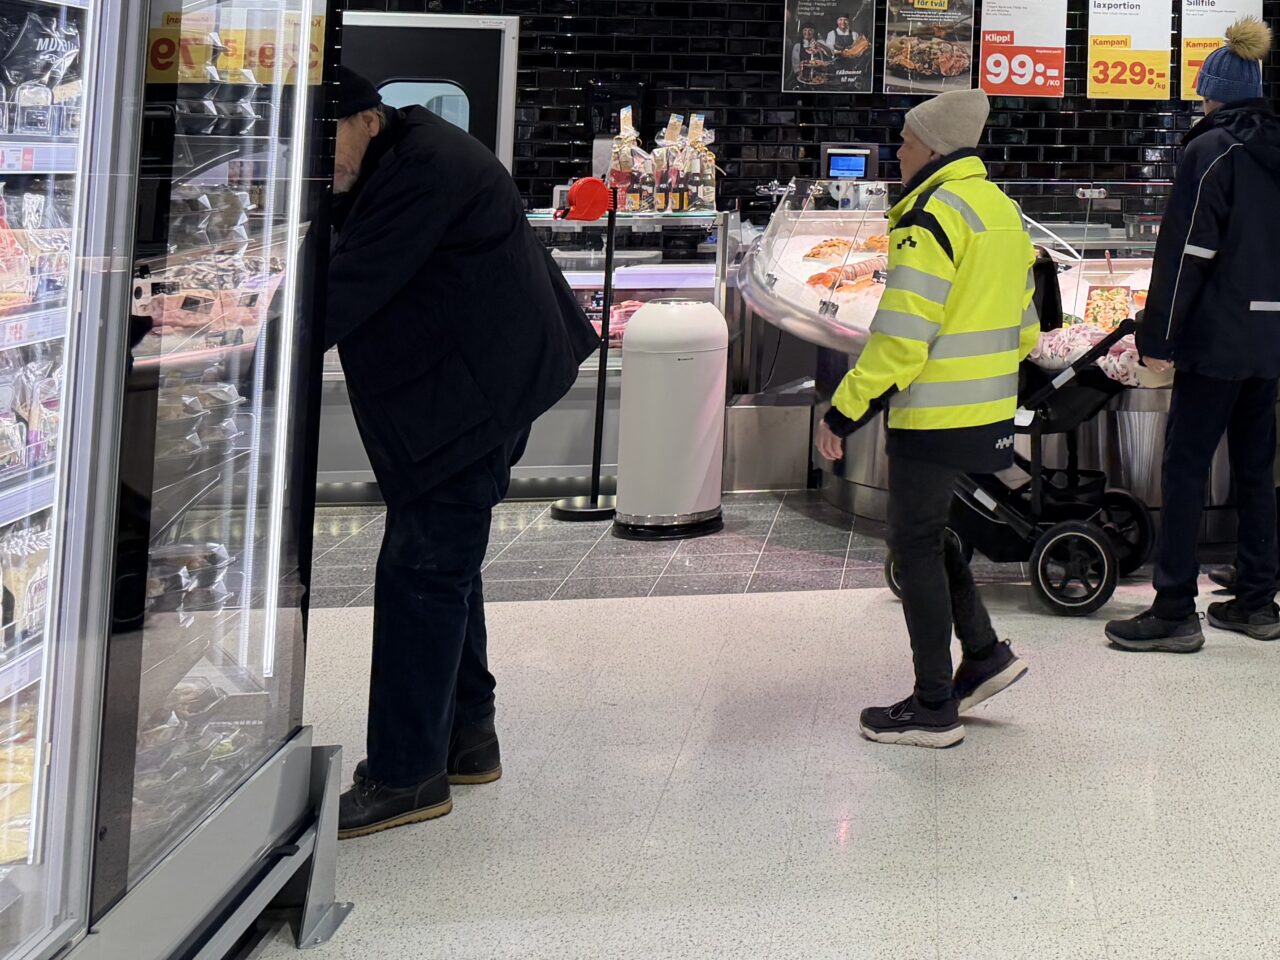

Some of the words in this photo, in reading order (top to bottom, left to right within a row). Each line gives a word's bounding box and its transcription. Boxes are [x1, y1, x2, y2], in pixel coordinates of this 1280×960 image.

[1093, 1, 1141, 10] laxportion
[985, 33, 1011, 42] Klipp!
[1093, 38, 1128, 46] Kampanj
[986, 53, 1059, 86] 99:-
[1092, 60, 1166, 85] 329:-
